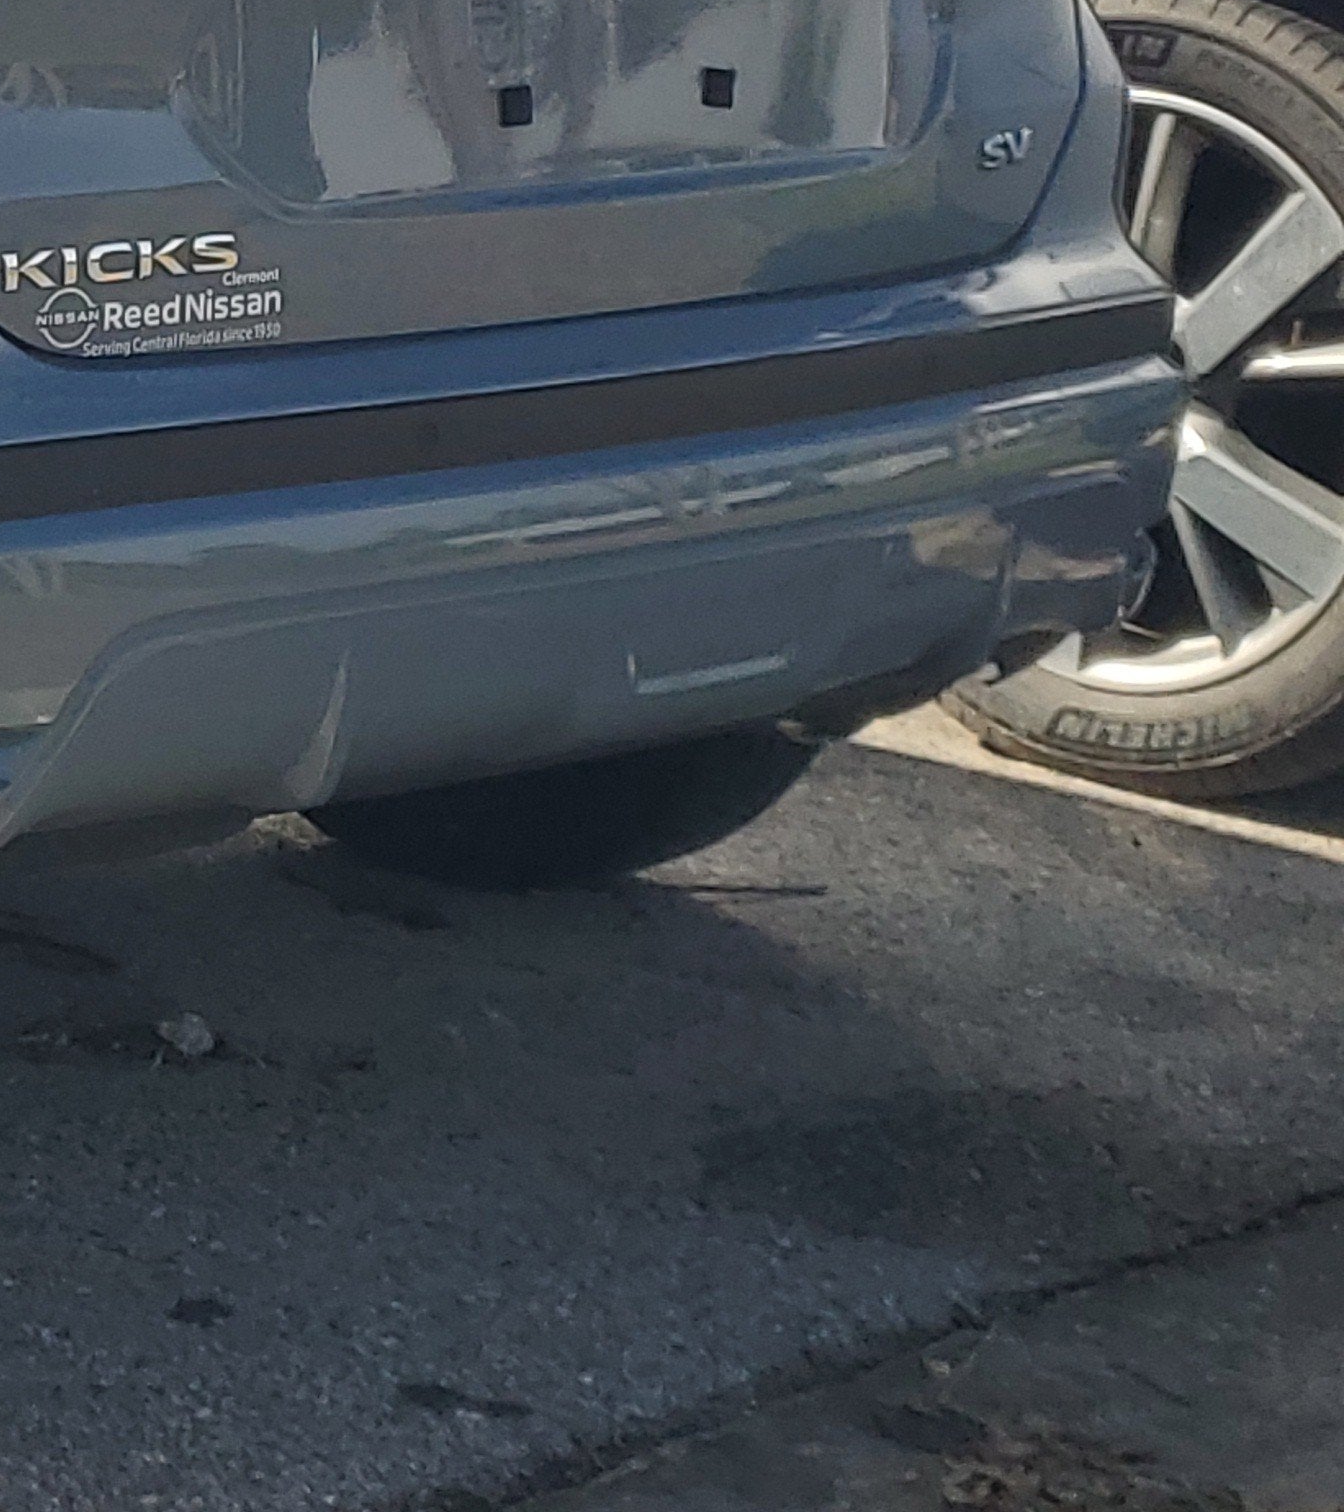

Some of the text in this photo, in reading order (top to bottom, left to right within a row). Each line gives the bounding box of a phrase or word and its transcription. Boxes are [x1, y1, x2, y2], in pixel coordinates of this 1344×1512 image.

[983, 127, 1034, 168] SV
[1, 234, 238, 292] KICKS
[222, 268, 279, 286] Clermont
[35, 308, 100, 326] NISSAN
[103, 289, 282, 331] Reed Nissan
[82, 341, 131, 357] Serving
[132, 334, 177, 353] Central
[178, 331, 219, 348] Florida
[222, 328, 254, 343] since
